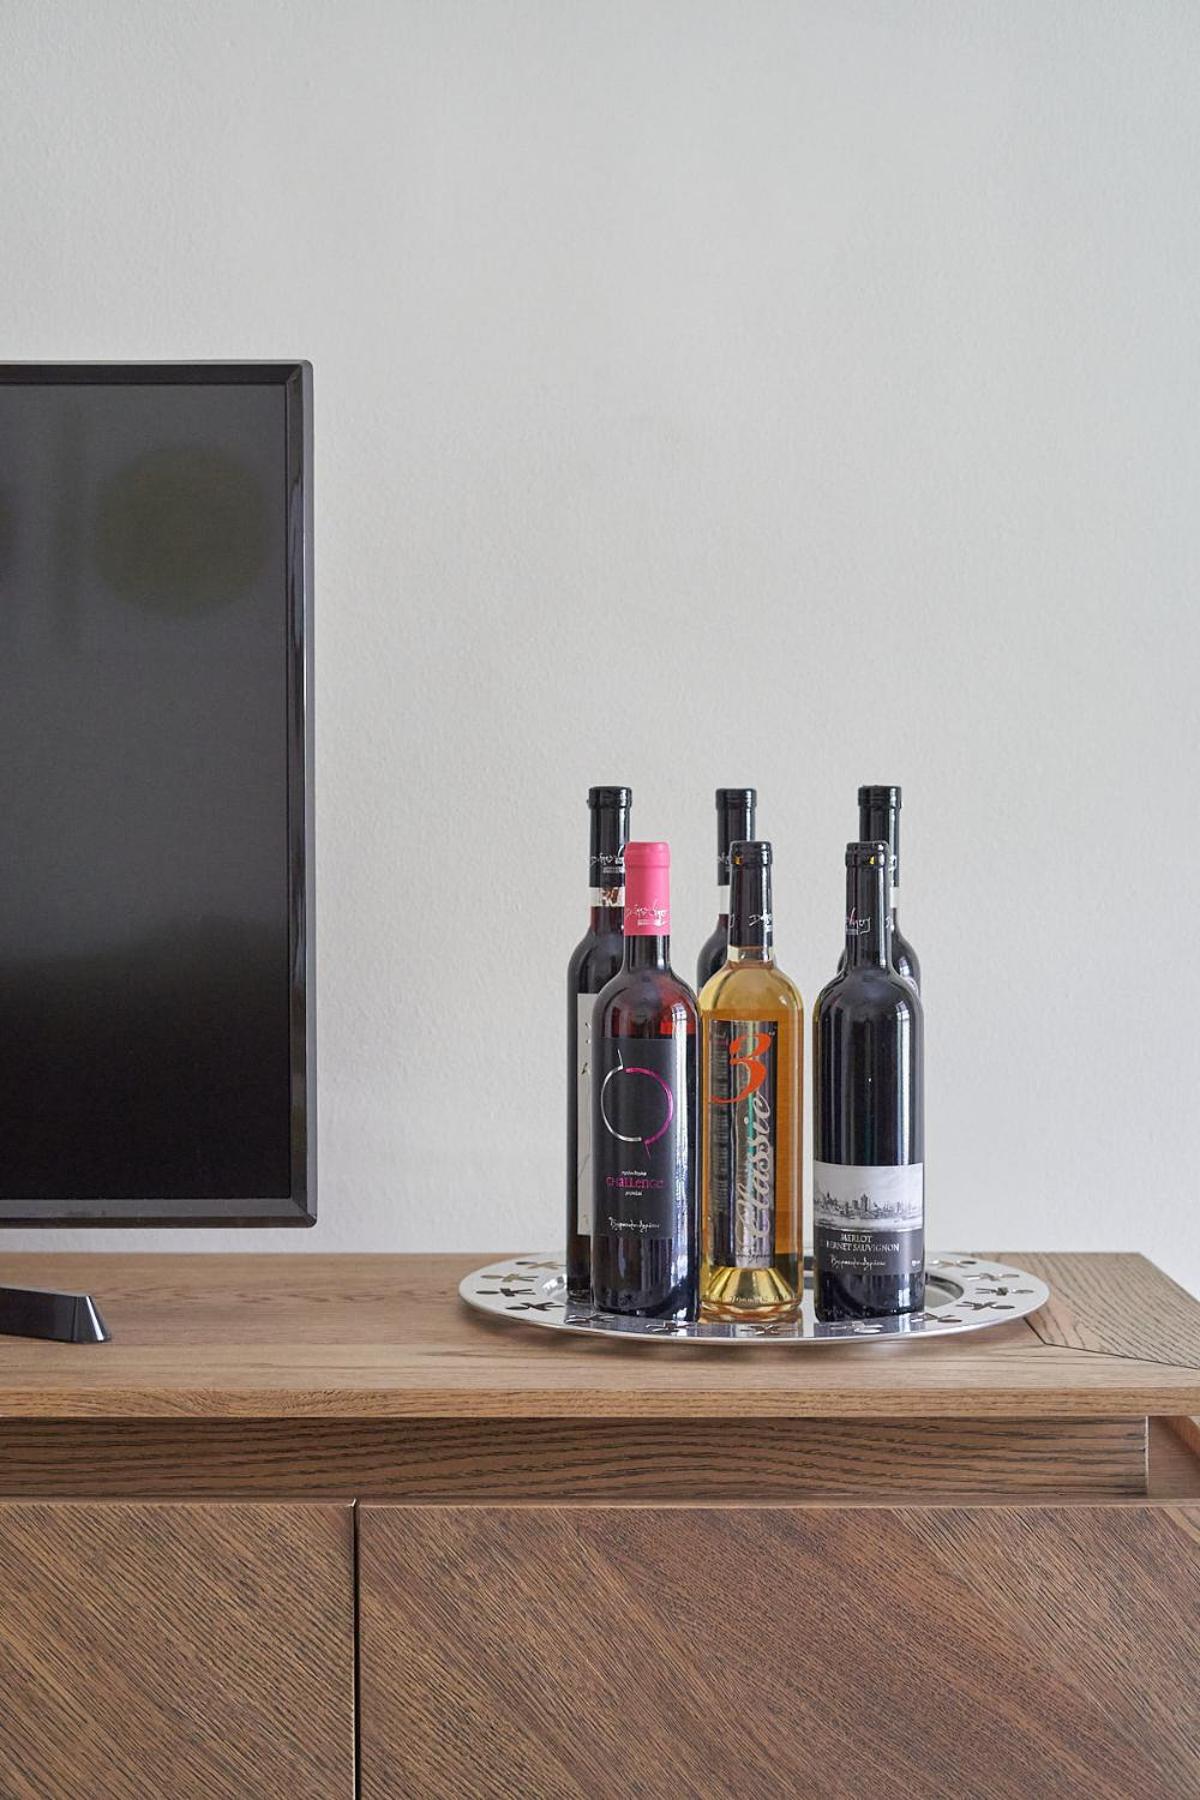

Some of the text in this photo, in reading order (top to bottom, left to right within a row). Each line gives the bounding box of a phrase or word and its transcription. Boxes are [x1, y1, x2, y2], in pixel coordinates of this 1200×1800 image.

[710, 1033, 772, 1104] 3
[735, 1090, 771, 1246] Classic
[840, 1233, 873, 1243] MERLOT
[853, 1241, 900, 1253] SAUVIGNON
